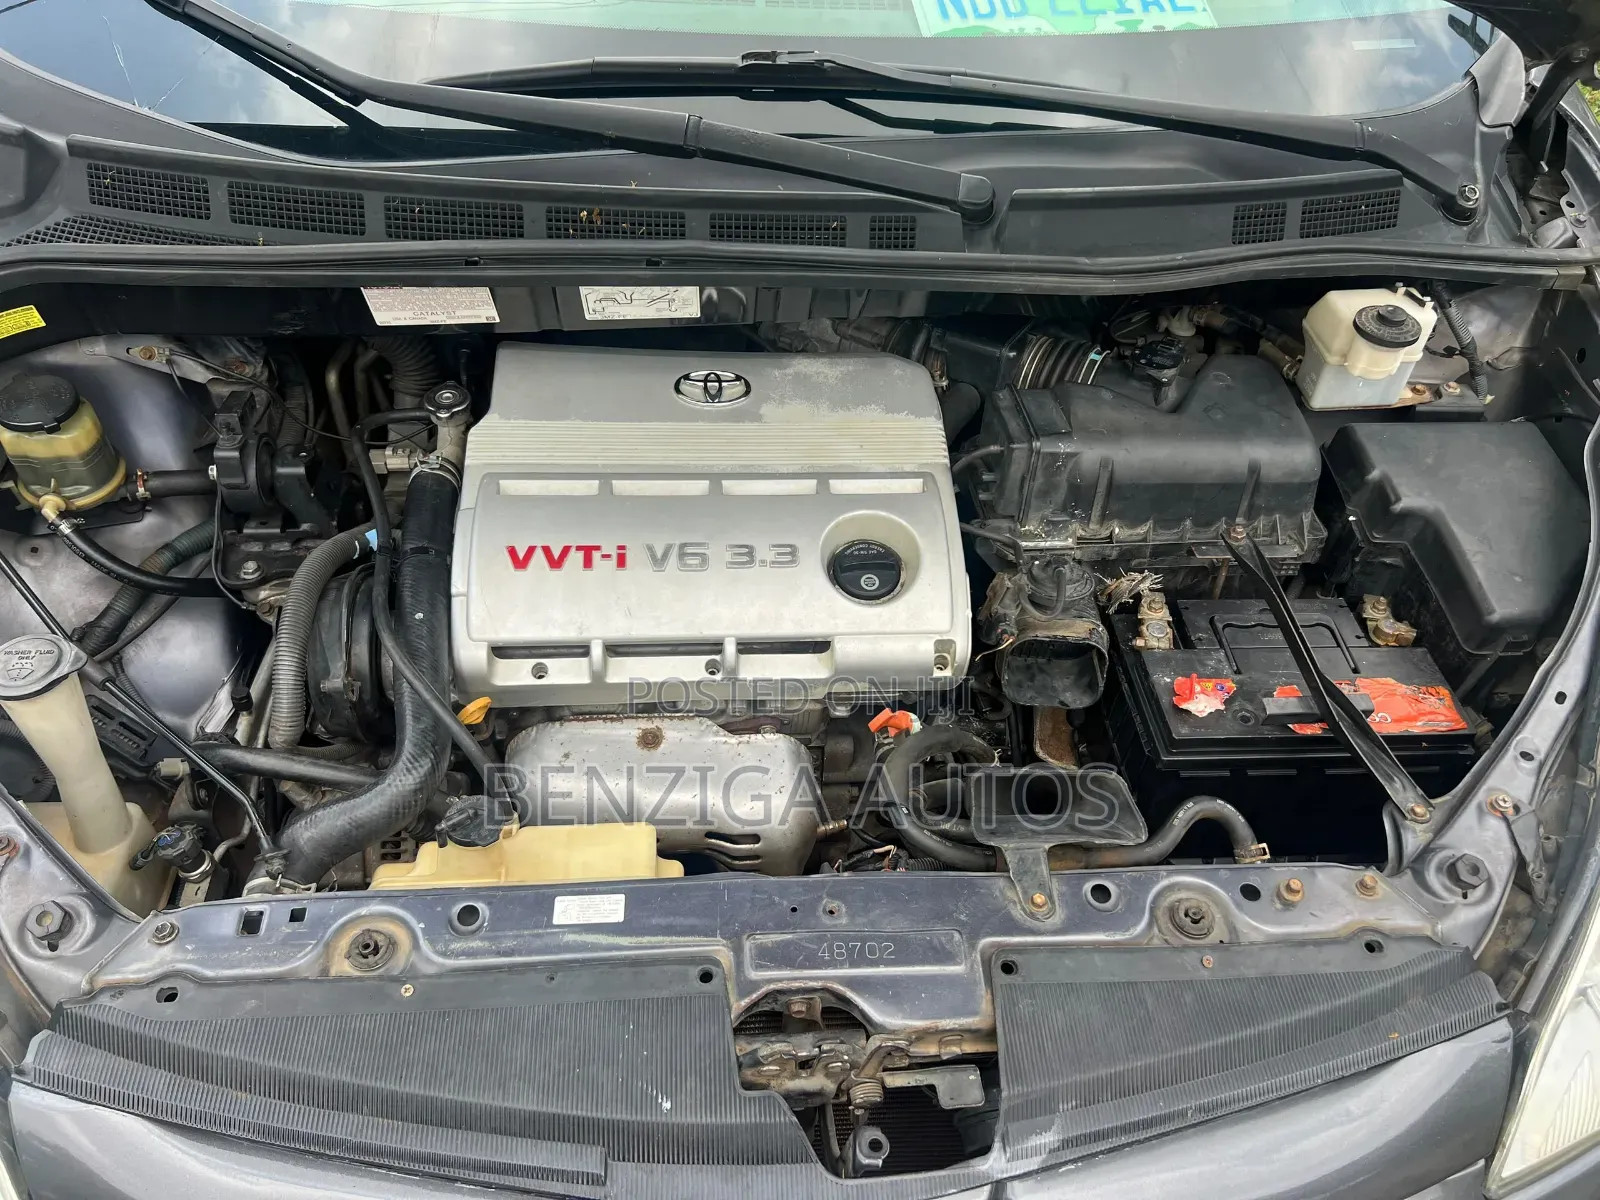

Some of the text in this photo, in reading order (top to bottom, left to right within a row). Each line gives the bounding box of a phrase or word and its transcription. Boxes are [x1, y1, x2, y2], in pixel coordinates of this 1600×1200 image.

[504, 541, 801, 573] VVT-i V6 3.3
[817, 941, 897, 960] 48702
